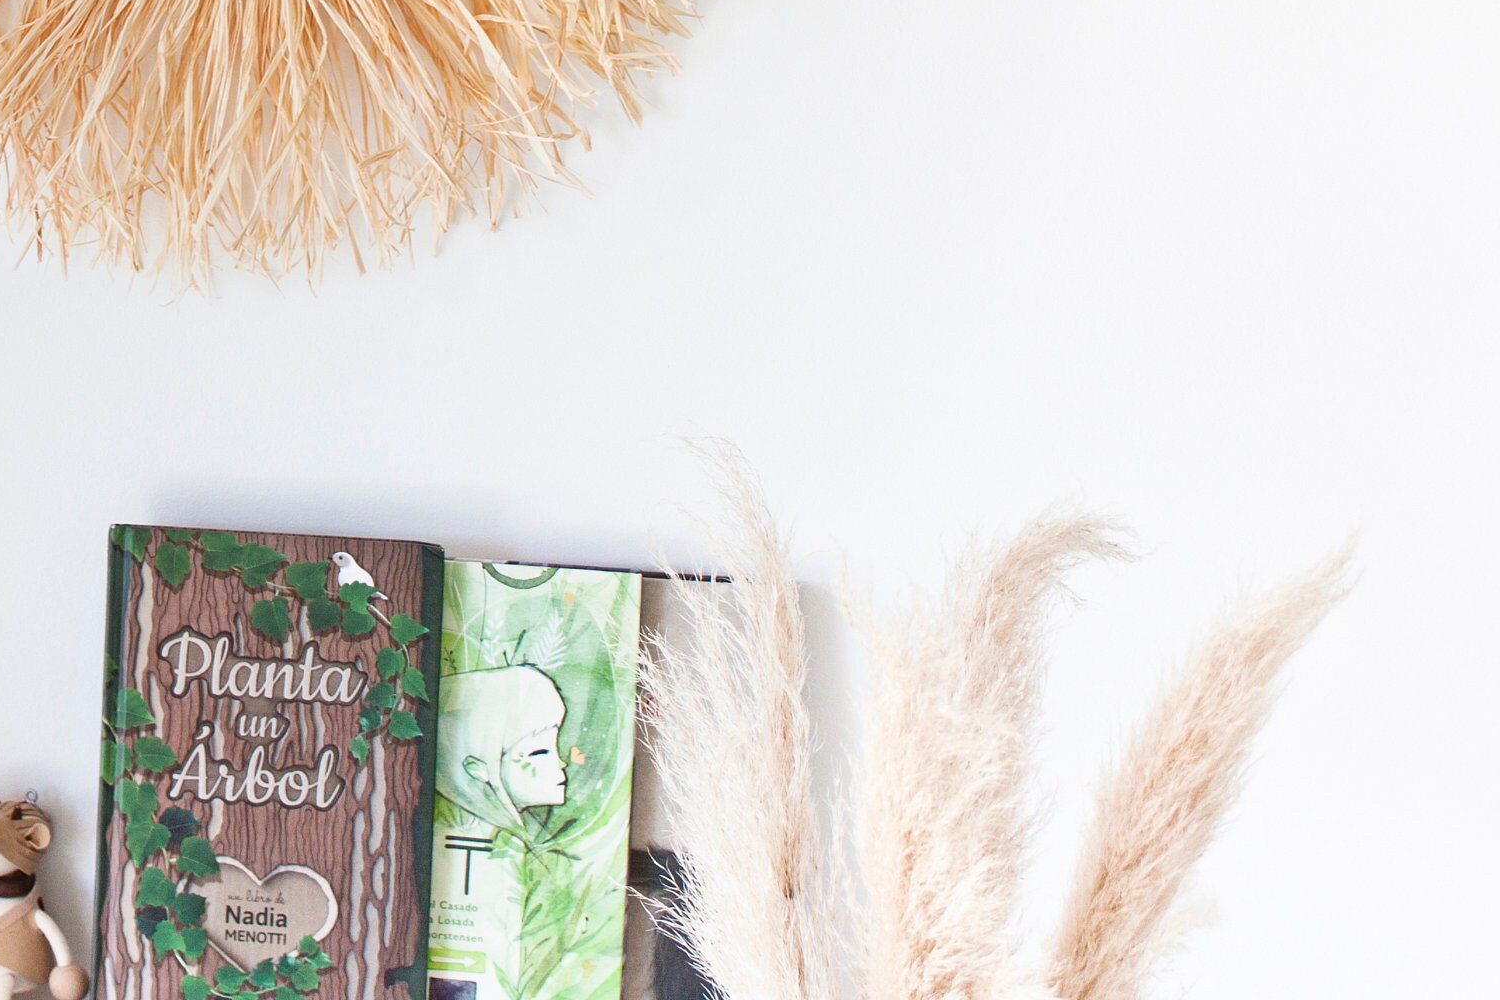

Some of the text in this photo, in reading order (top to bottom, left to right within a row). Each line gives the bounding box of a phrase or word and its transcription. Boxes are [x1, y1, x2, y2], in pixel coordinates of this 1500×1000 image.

[161, 631, 365, 703] Planta
[238, 714, 286, 739] un
[169, 725, 341, 809] Árbol
[225, 904, 288, 928] Nadia
[439, 900, 479, 913] Casado
[437, 915, 475, 928] Losada
[224, 929, 287, 946] MENOTTI
[429, 931, 484, 943] orstensen
